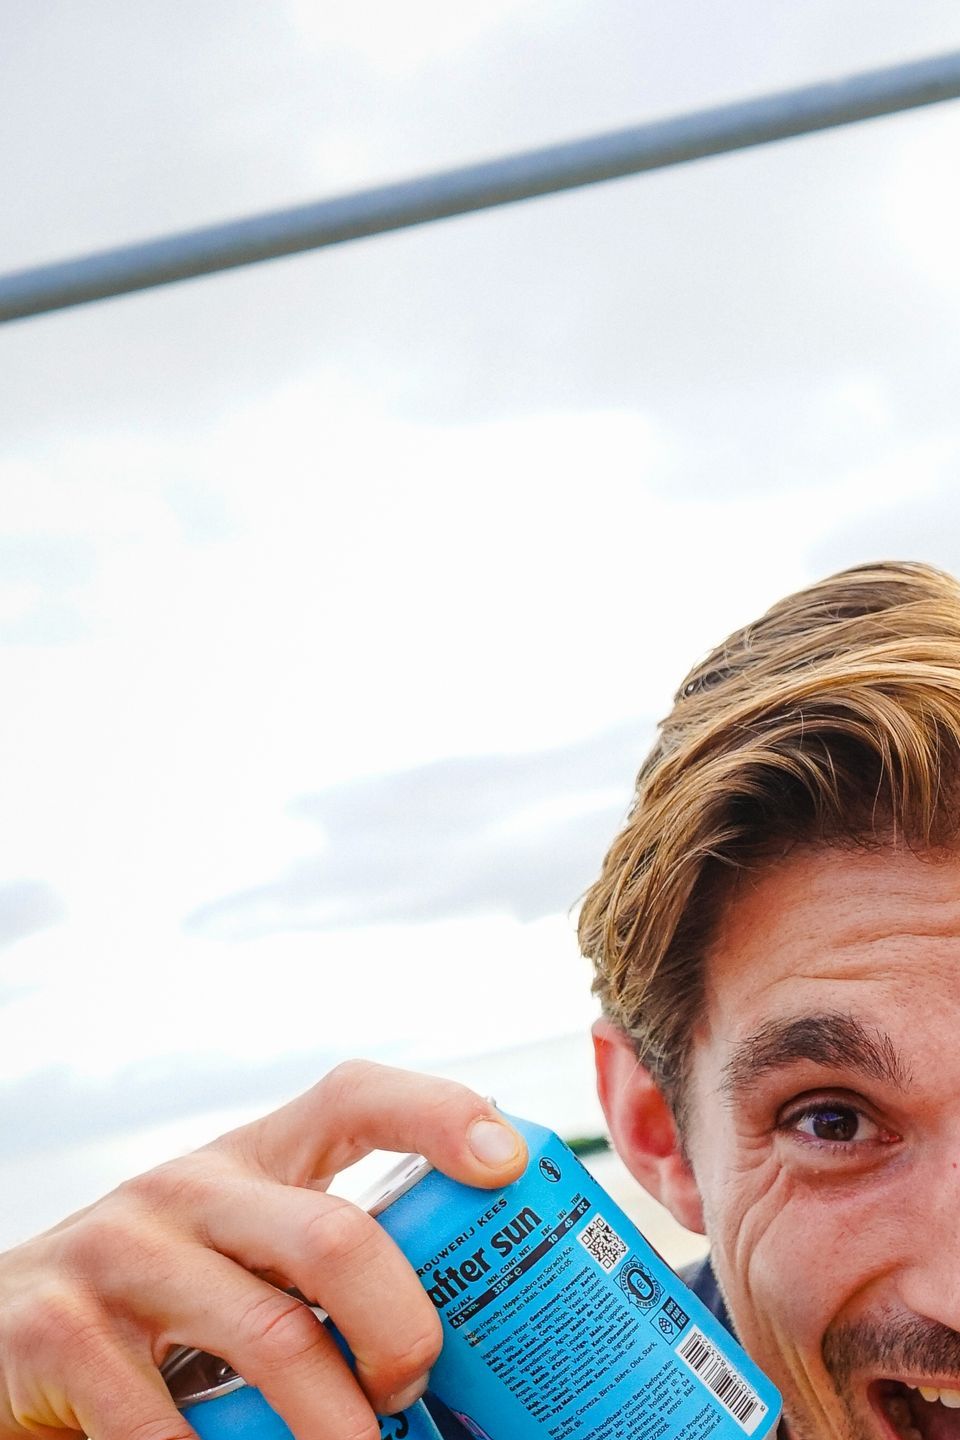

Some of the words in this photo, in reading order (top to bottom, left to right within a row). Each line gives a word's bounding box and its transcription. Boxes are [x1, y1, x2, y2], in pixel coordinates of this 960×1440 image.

[415, 1226, 475, 1279] ROUWERIJ
[476, 1198, 507, 1227] KEES
[547, 1233, 558, 1244] 10
[564, 1217, 574, 1228] 45
[426, 1248, 491, 1309] after
[490, 1207, 542, 1257] sun
[579, 1271, 596, 1288] Barley
[462, 1327, 481, 1343] Vegan
[502, 1294, 521, 1311] Hops:
[519, 1280, 537, 1296] Sabro
[536, 1273, 545, 1281] en
[542, 1253, 564, 1275] Sorachi
[497, 1309, 516, 1325] Tarwe
[515, 1302, 524, 1311] en
[537, 1272, 558, 1291] Yeast:
[586, 1309, 594, 1317] de
[593, 1408, 622, 1433] houdbaar
[631, 1387, 646, 1401] Best
[643, 1369, 664, 1389] before:
[624, 1394, 651, 1419] Consumir
[625, 1412, 657, 1440] preference
[657, 1395, 674, 1411] avant
[626, 1409, 647, 1428] Mindst
[647, 1387, 670, 1409] holdbar
[685, 1402, 712, 1429] Produziert
